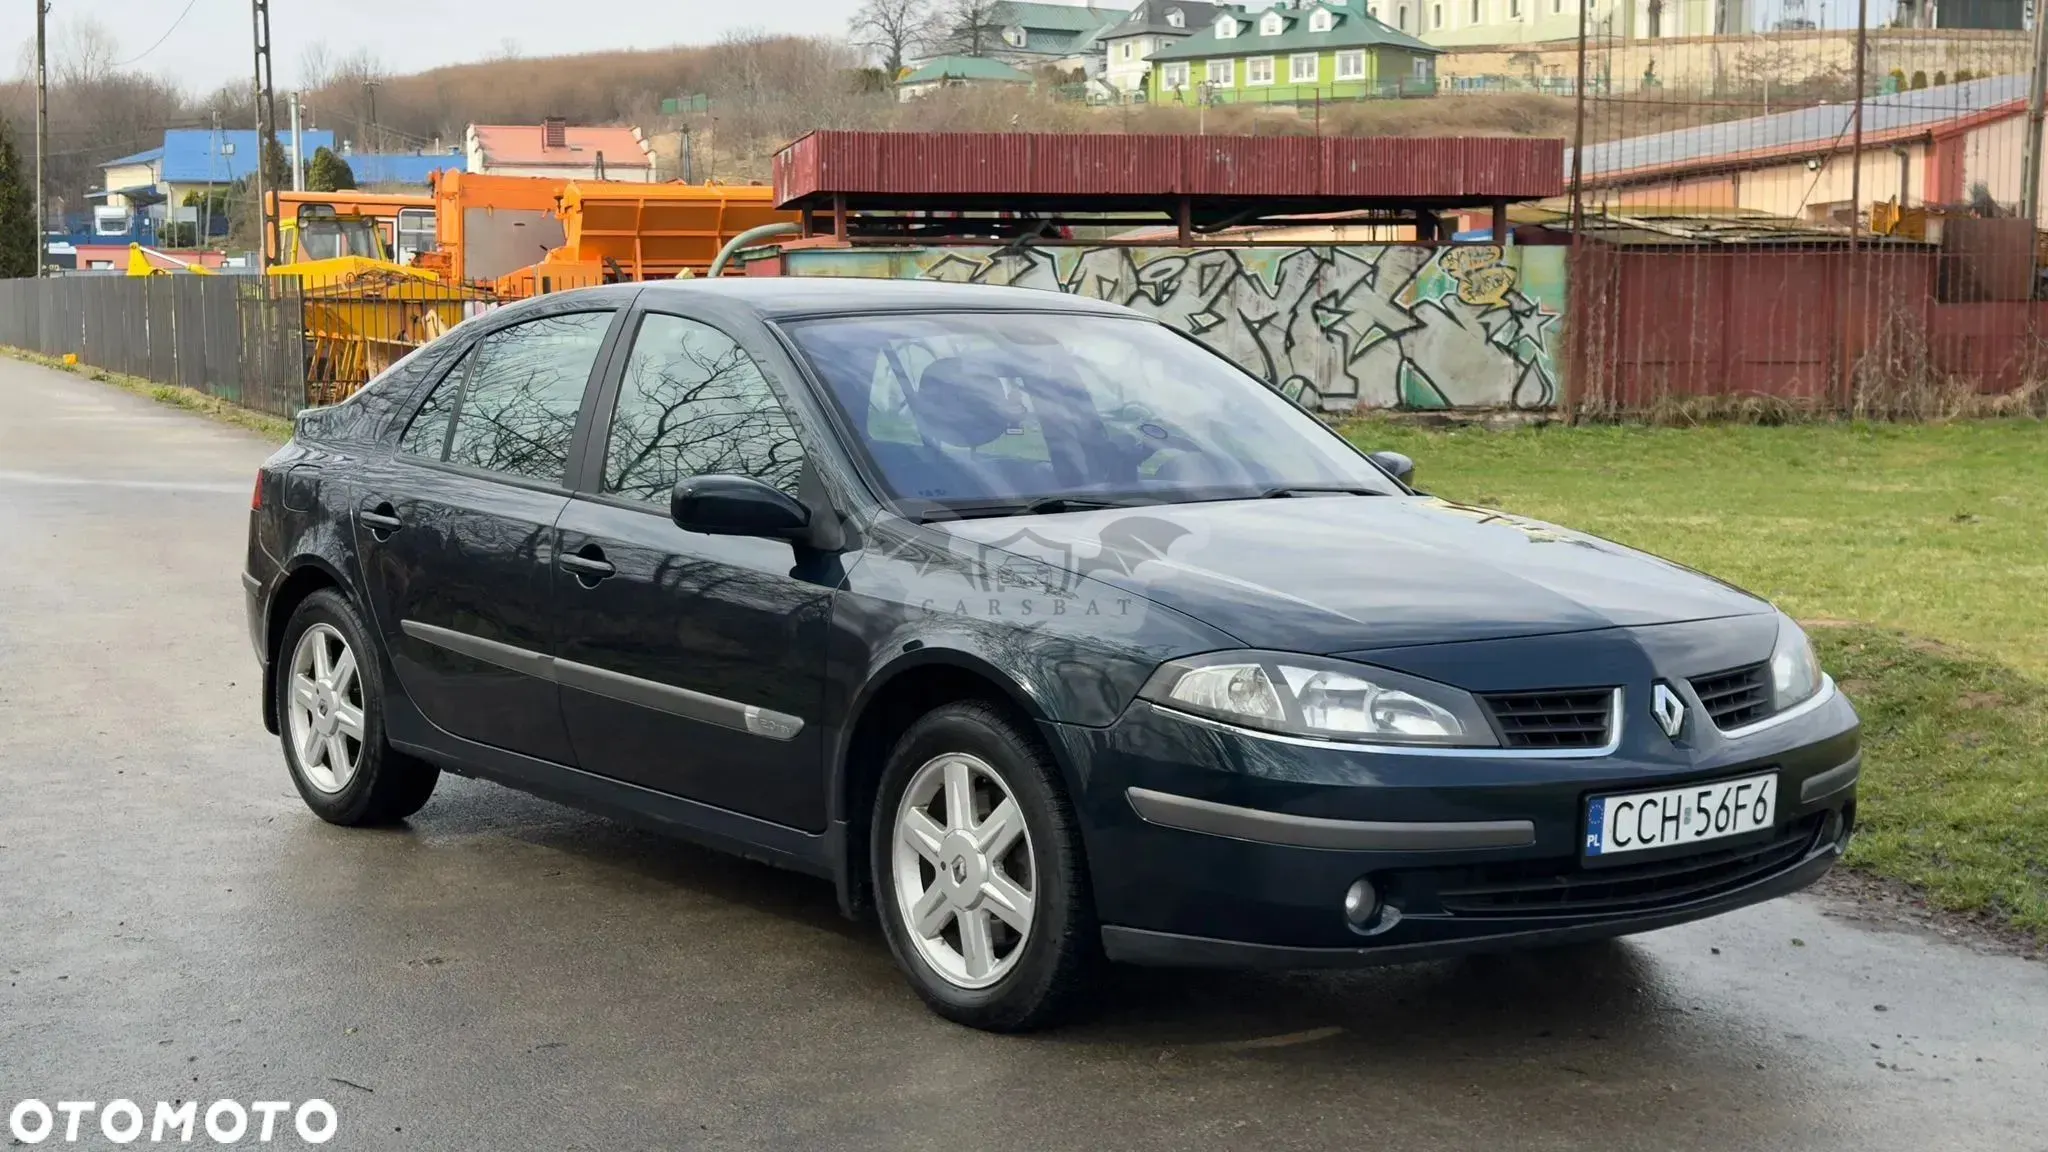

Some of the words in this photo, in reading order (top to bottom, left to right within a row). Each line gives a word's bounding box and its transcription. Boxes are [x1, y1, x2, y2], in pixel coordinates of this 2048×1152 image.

[1612, 794, 1682, 848] CCH
[1693, 780, 1770, 837] 56F6
[1586, 833, 1600, 848] PL
